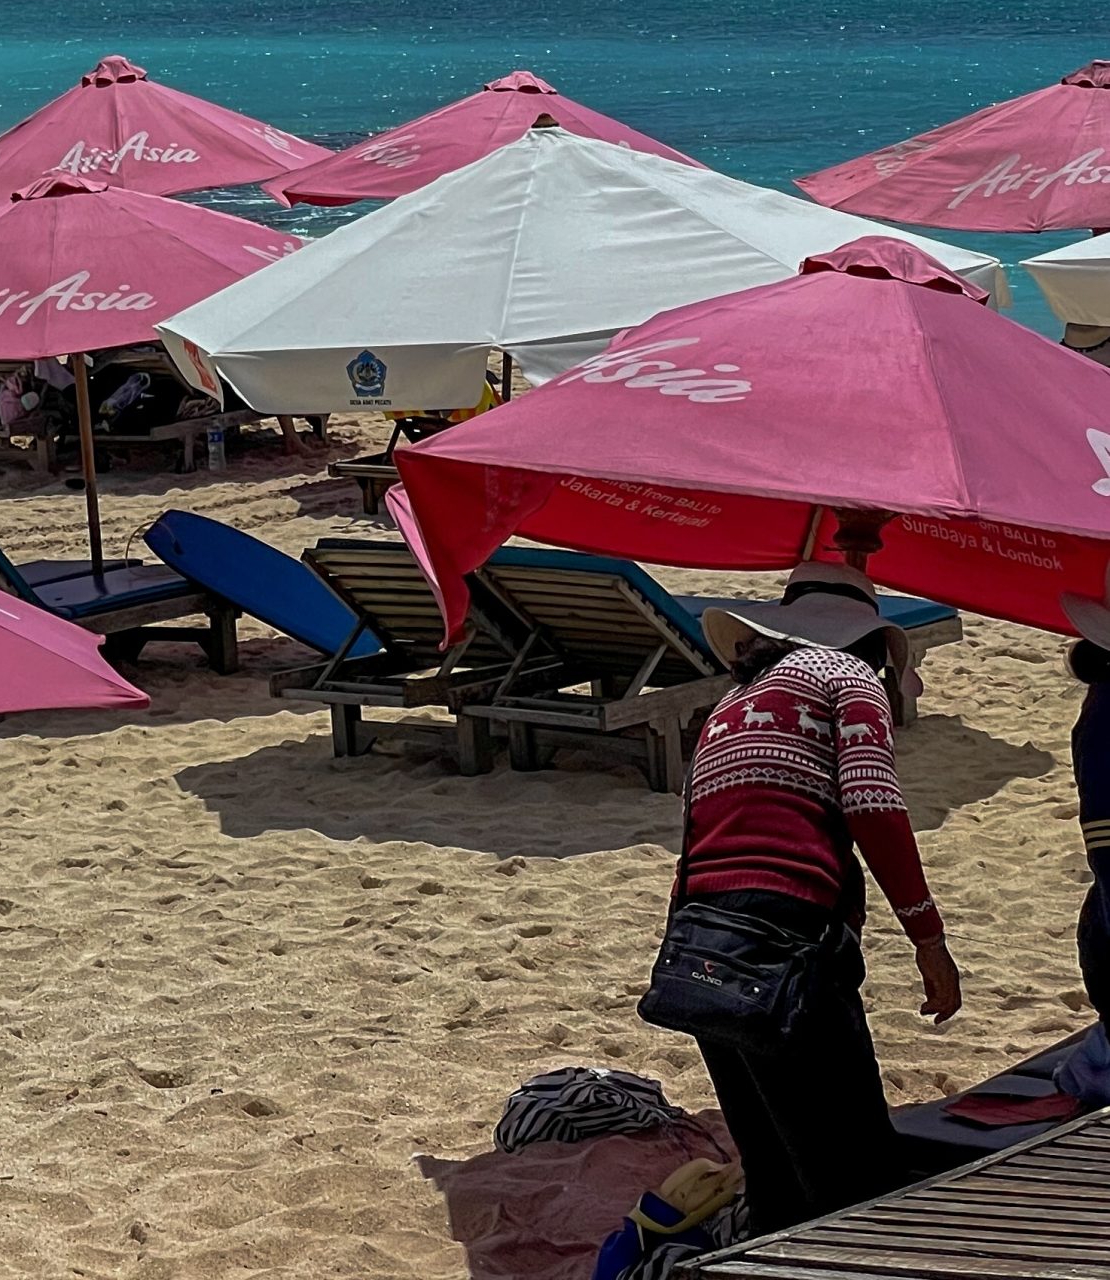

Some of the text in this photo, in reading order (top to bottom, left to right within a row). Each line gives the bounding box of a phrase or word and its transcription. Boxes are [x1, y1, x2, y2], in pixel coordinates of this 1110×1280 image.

[560, 477, 712, 529] Jakarta & Kertajati
[642, 487, 674, 504] from
[675, 497, 708, 512] BALI
[707, 504, 722, 515] to
[902, 514, 1064, 570] Surabaya & Lombok
[1002, 525, 1037, 546] BALI
[1041, 535, 1057, 549] to
